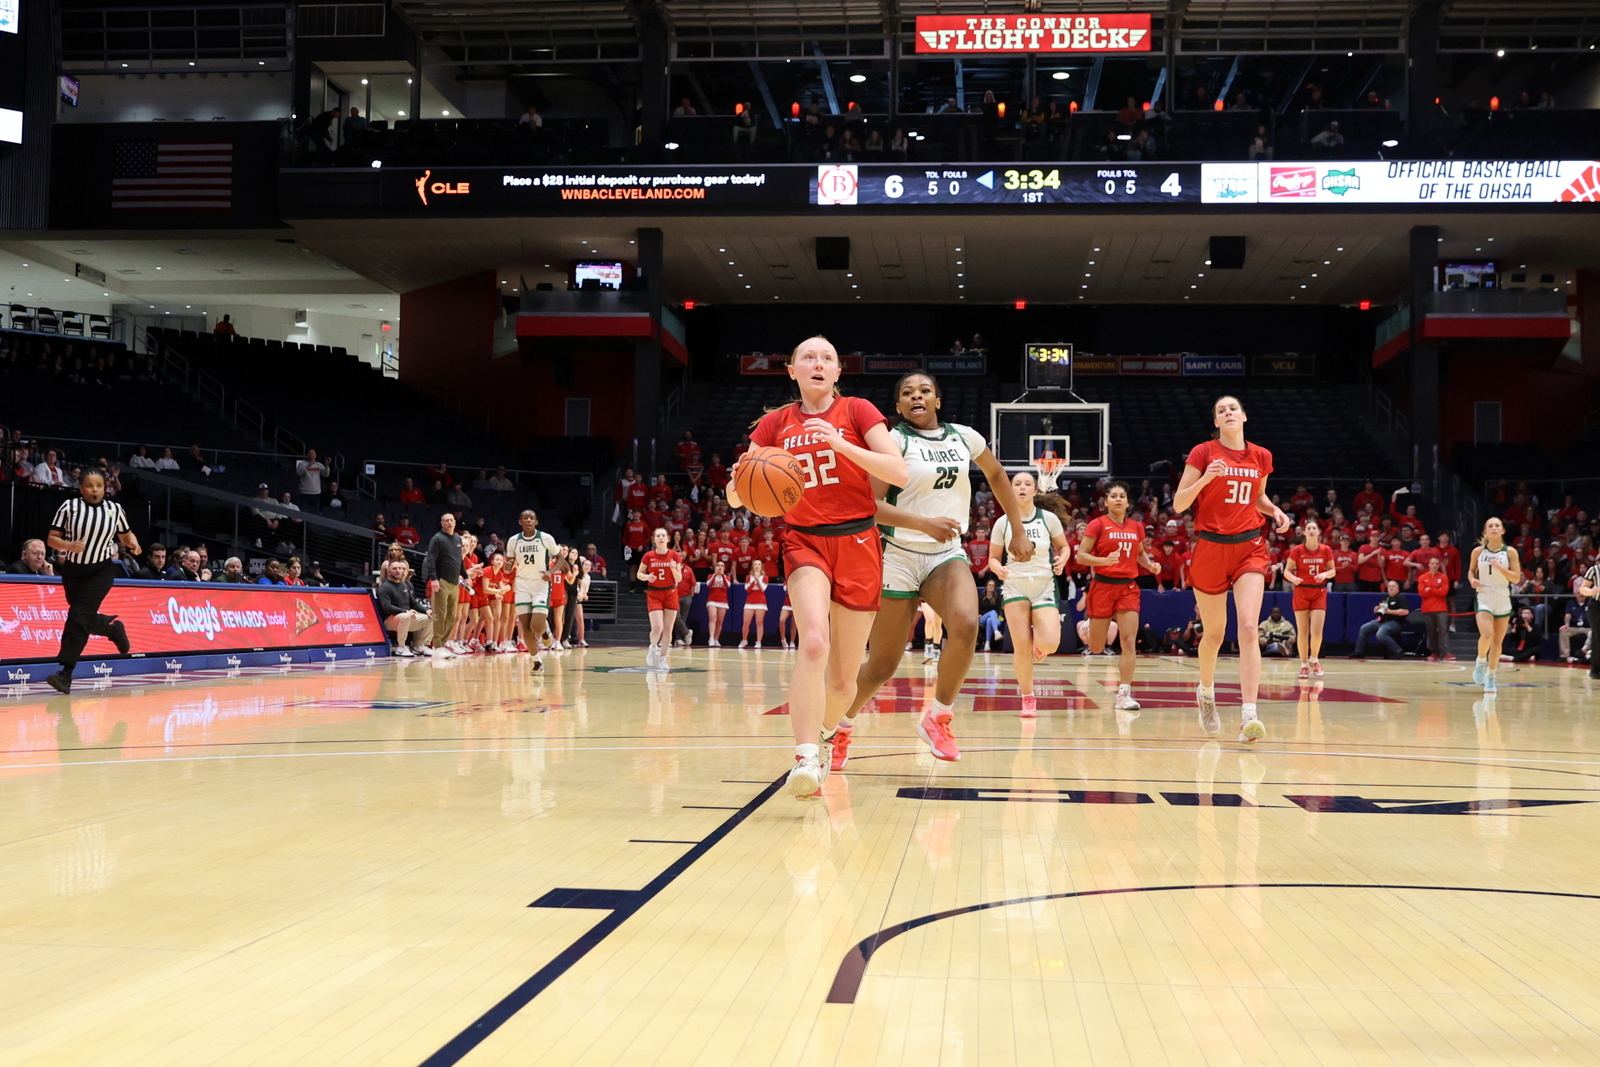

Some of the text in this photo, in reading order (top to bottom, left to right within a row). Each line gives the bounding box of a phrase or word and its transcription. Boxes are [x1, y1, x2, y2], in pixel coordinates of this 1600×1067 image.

[966, 17, 1100, 30] THE CONNOR
[938, 28, 1130, 50] FLIGHT DECK
[1388, 160, 1562, 178] OFFICIAL BASKETBALL
[503, 175, 532, 186] Place
[534, 178, 540, 186] a
[565, 175, 595, 186] initial
[597, 174, 638, 188] deposit
[639, 176, 652, 185] or
[652, 174, 702, 188] purchase
[704, 175, 729, 187] gear
[730, 174, 765, 186] today!
[832, 176, 846, 192] B
[1004, 169, 1061, 190] 3:34
[1160, 172, 1182, 197] 4
[431, 182, 470, 194] CLE
[561, 188, 705, 199] WNBACLEVELAND.COM
[884, 175, 904, 199] 6
[928, 181, 960, 195] 5 0
[1105, 180, 1136, 194] 0 5
[1419, 183, 1532, 199] OF THE OHSAA
[1022, 192, 1044, 203] 1ST
[1039, 348, 1068, 362] 3:34
[1185, 362, 1212, 370] SAINT
[1215, 362, 1242, 370] LOUIS
[1272, 362, 1296, 370] VCU
[920, 448, 964, 463] LAUREL
[795, 449, 840, 489] 32
[1224, 466, 1259, 478] ELLEVUE
[933, 466, 959, 489] 25
[1224, 480, 1252, 504] 30
[519, 545, 539, 553] LAUREL
[1118, 542, 1132, 558] 14
[524, 554, 535, 565] 24
[658, 568, 665, 580] 2
[1489, 564, 1492, 575] 1
[554, 575, 562, 584] 13
[11, 606, 39, 621] You'll
[151, 597, 288, 641] Join Casey's REWARDS today!
[20, 626, 32, 641] all
[34, 628, 54, 644] your
